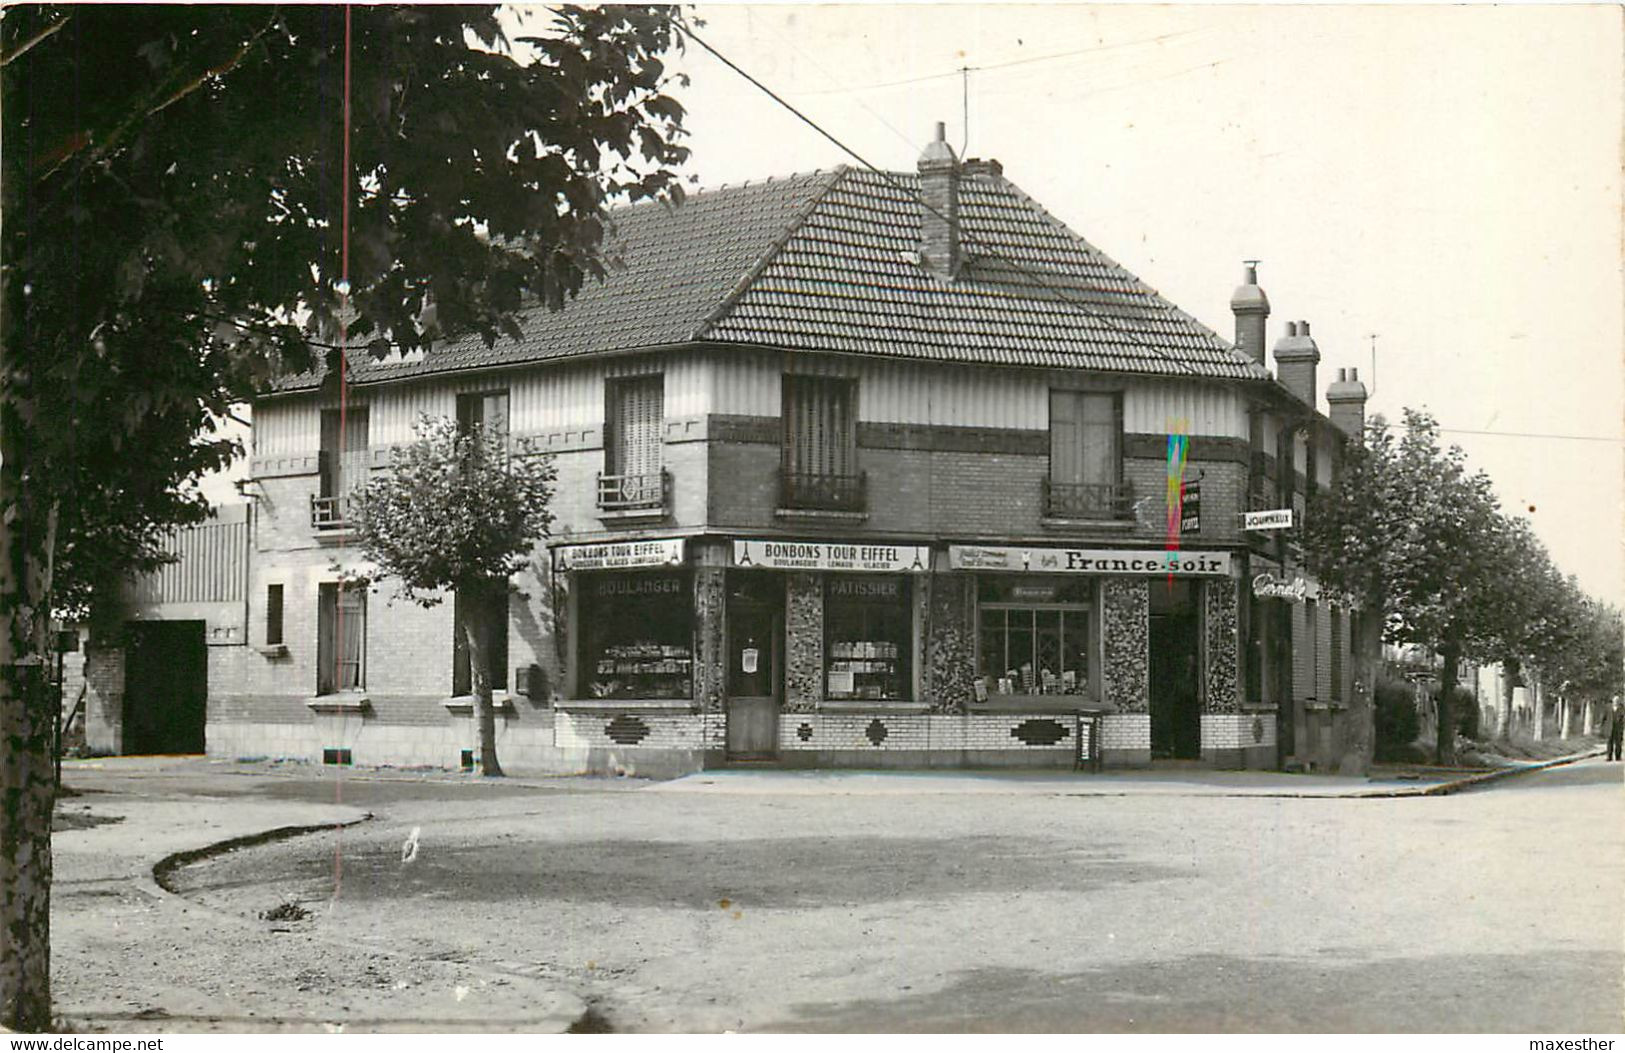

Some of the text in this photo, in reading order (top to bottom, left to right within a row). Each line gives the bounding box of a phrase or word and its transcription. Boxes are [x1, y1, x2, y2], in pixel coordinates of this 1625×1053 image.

[571, 543, 665, 560] BONBONS TOUR EIFFEL
[765, 543, 899, 562] BONBONS TOUR EIFFEL
[599, 579, 680, 595] BOULANGER
